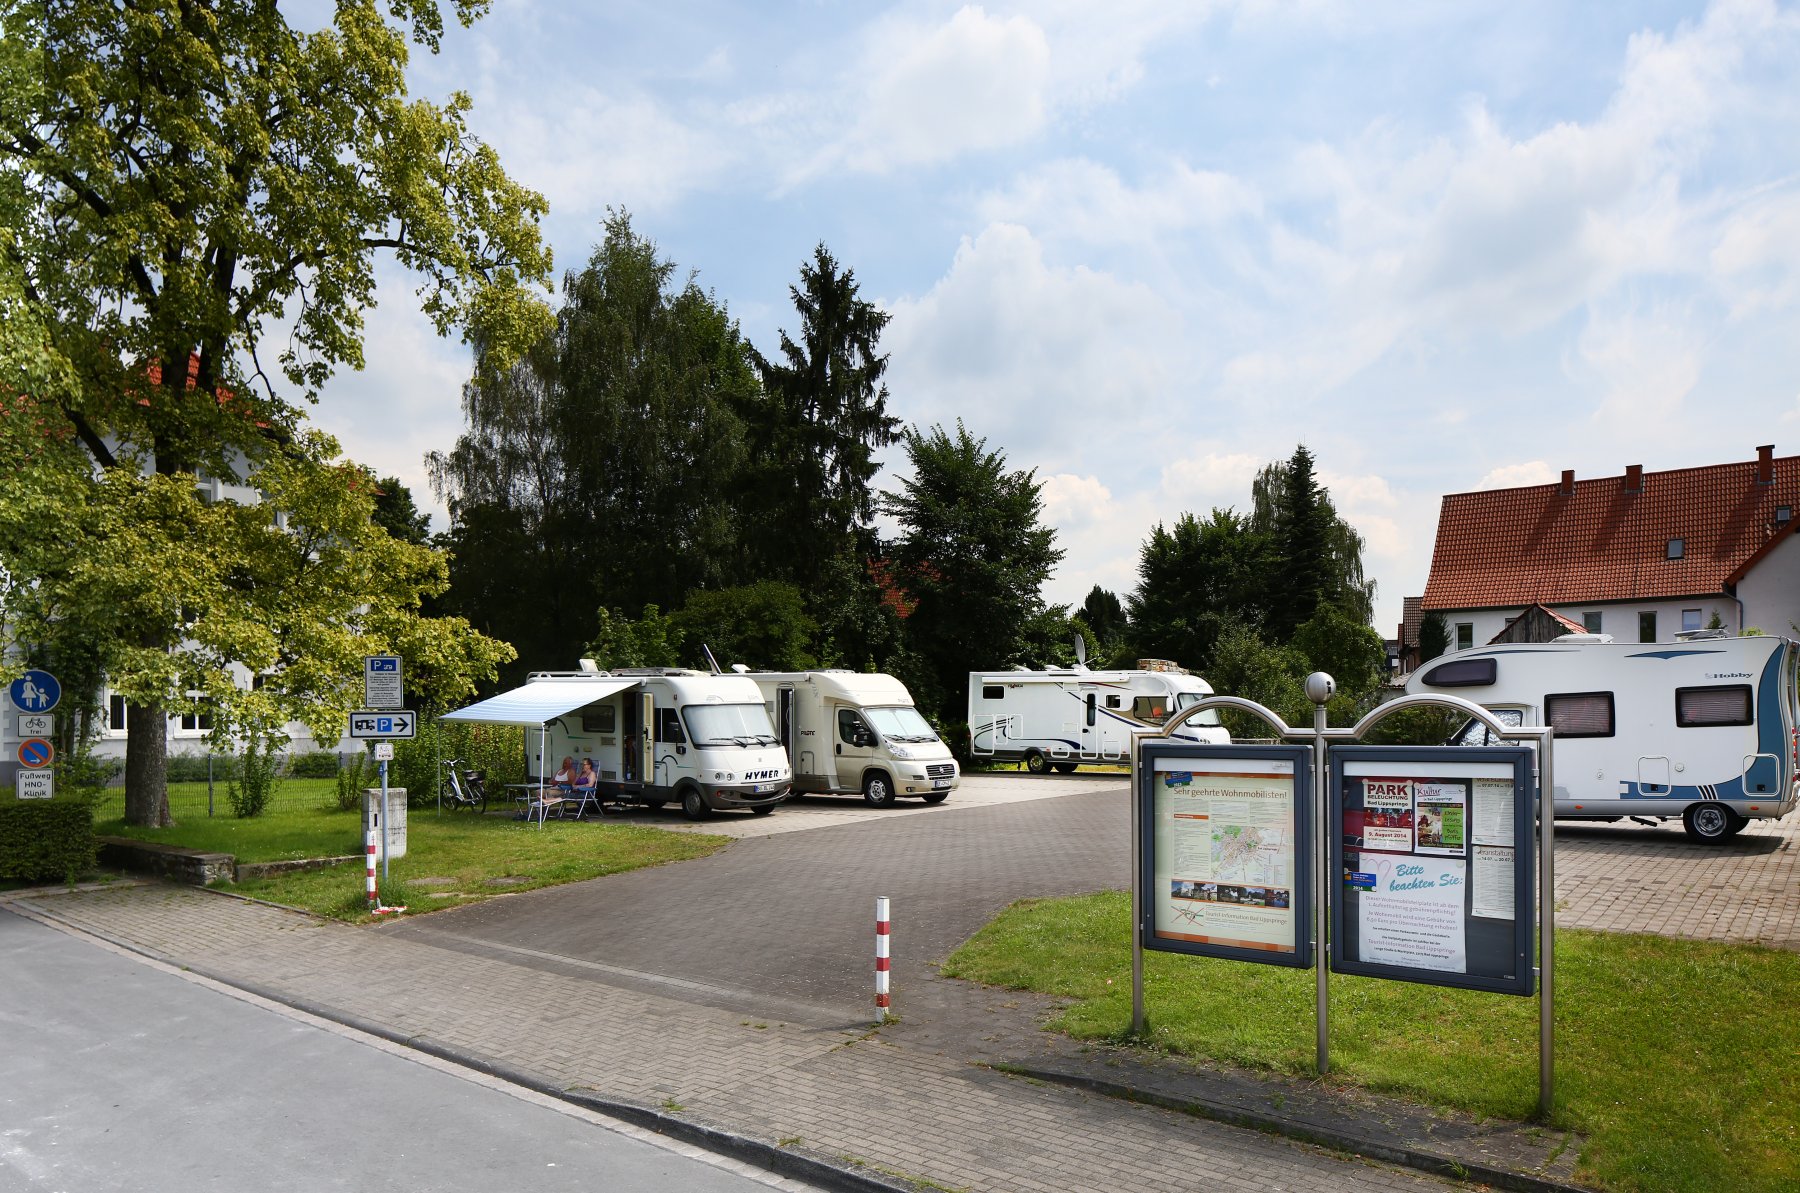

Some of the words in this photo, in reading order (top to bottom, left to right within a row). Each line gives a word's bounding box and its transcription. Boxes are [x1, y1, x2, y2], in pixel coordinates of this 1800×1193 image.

[374, 661, 382, 670] P
[380, 720, 388, 731] P
[744, 770, 779, 780] HYMER
[1174, 787, 1190, 795] Sehr
[1191, 789, 1220, 797] geehrte
[1220, 789, 1287, 799] Wohnmobilisten!
[1367, 784, 1408, 796] PARK
[1417, 786, 1442, 796] Kultur
[1396, 864, 1424, 877] Bitte
[1390, 878, 1435, 892] beachten
[1439, 874, 1463, 887] Sie:
